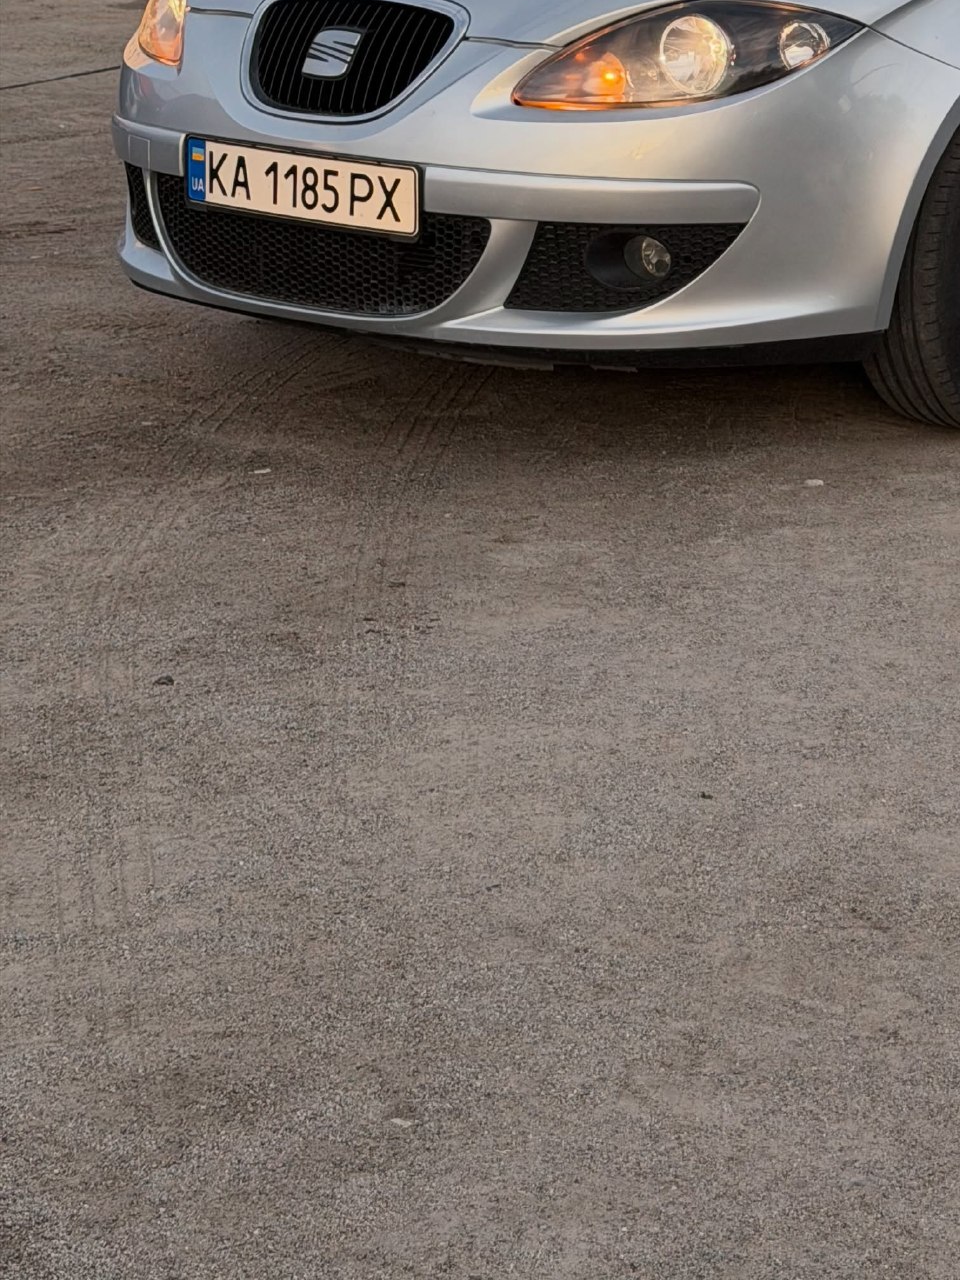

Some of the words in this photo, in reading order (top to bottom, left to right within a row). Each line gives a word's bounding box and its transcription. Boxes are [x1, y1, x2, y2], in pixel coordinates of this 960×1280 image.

[191, 176, 205, 193] UA
[208, 150, 252, 201] KA
[264, 161, 340, 214] 1185
[349, 172, 402, 223] PX
